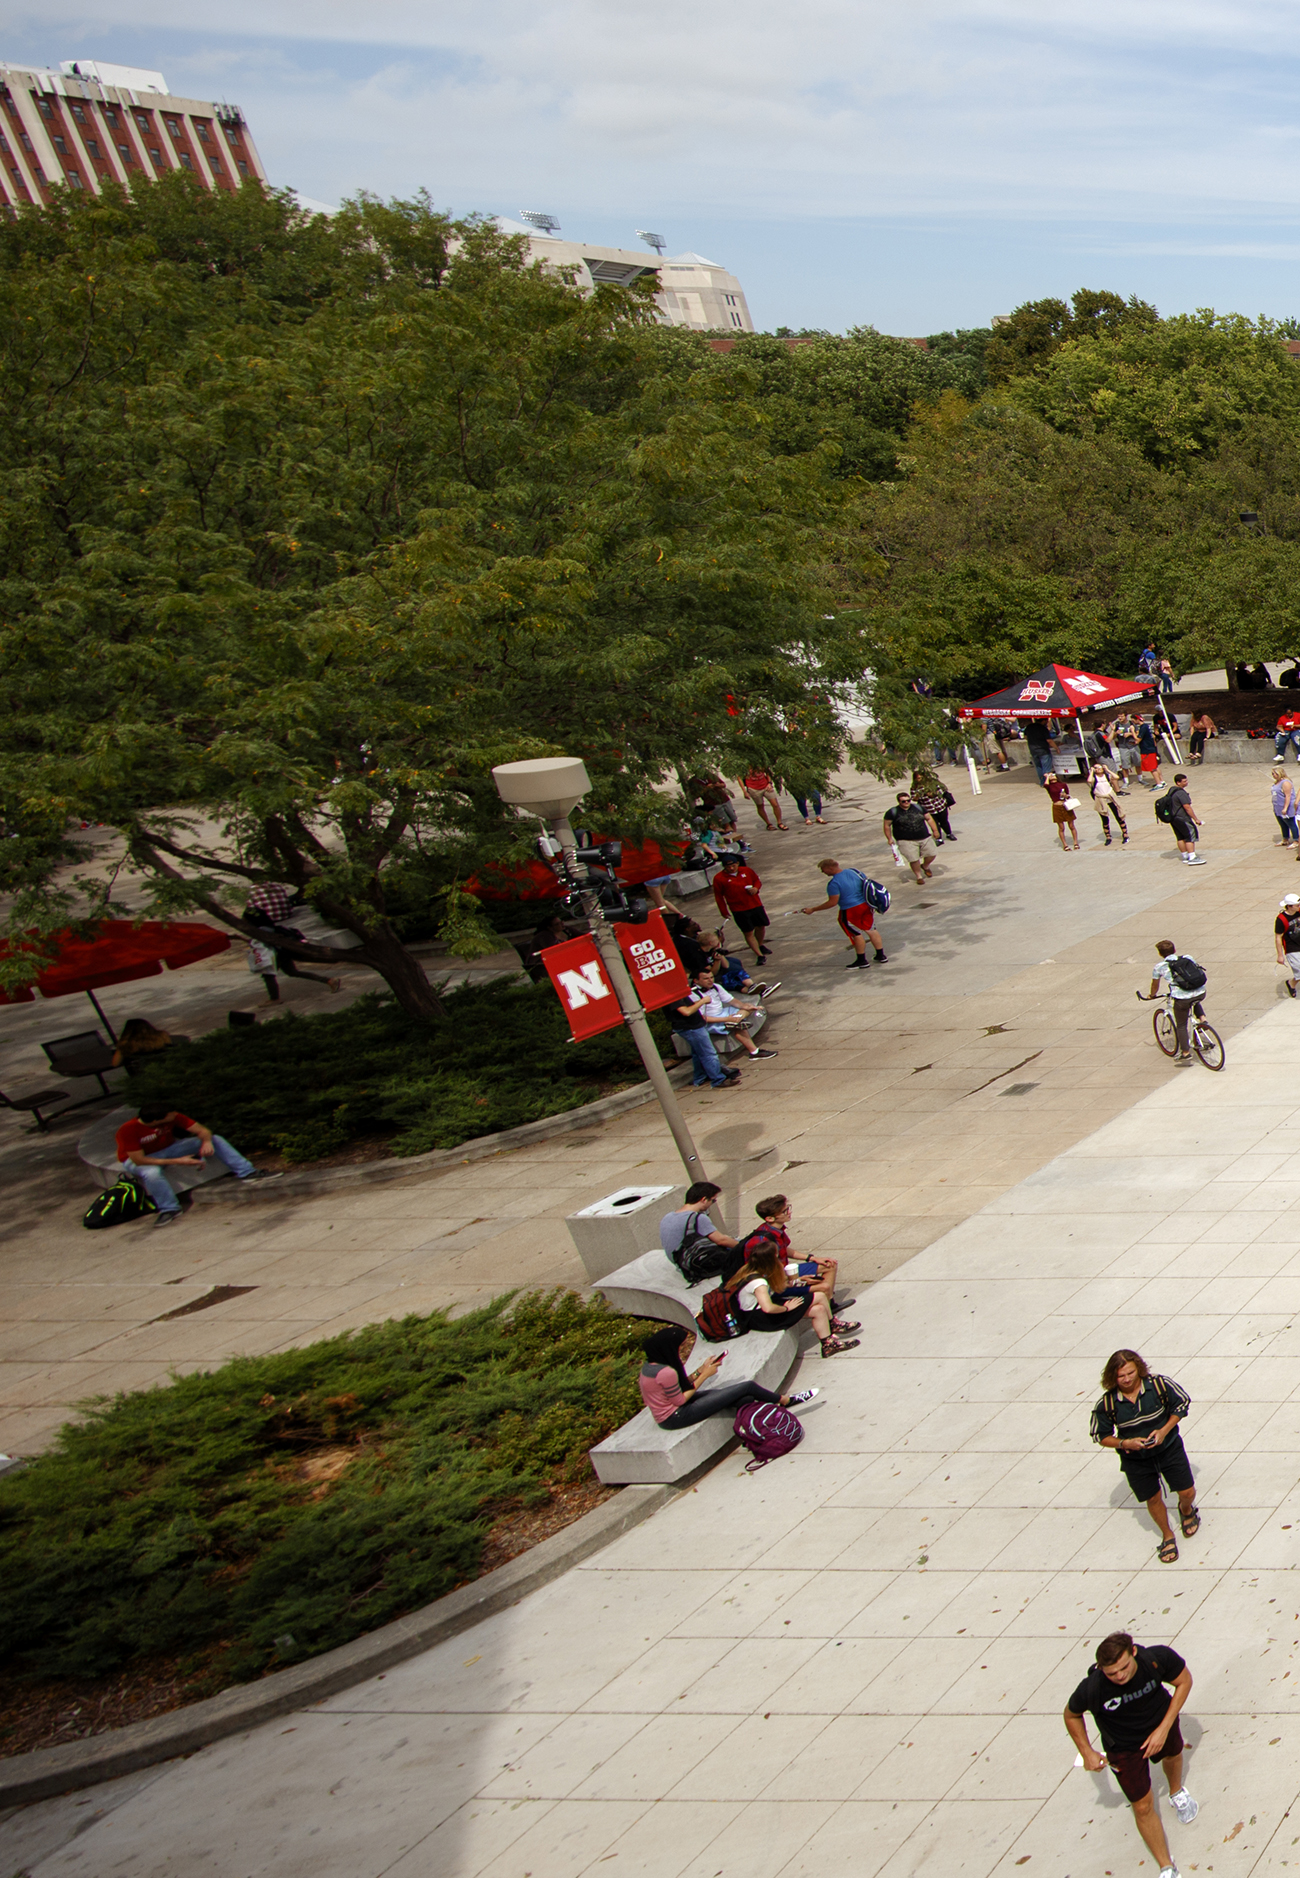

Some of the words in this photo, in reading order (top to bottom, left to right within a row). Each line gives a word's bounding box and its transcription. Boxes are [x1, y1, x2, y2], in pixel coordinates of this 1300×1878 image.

[630, 939, 655, 957] GO
[634, 948, 666, 969] BIG
[639, 958, 676, 981] RED
[557, 960, 611, 1010] N
[1122, 1679, 1157, 1704] hudl
